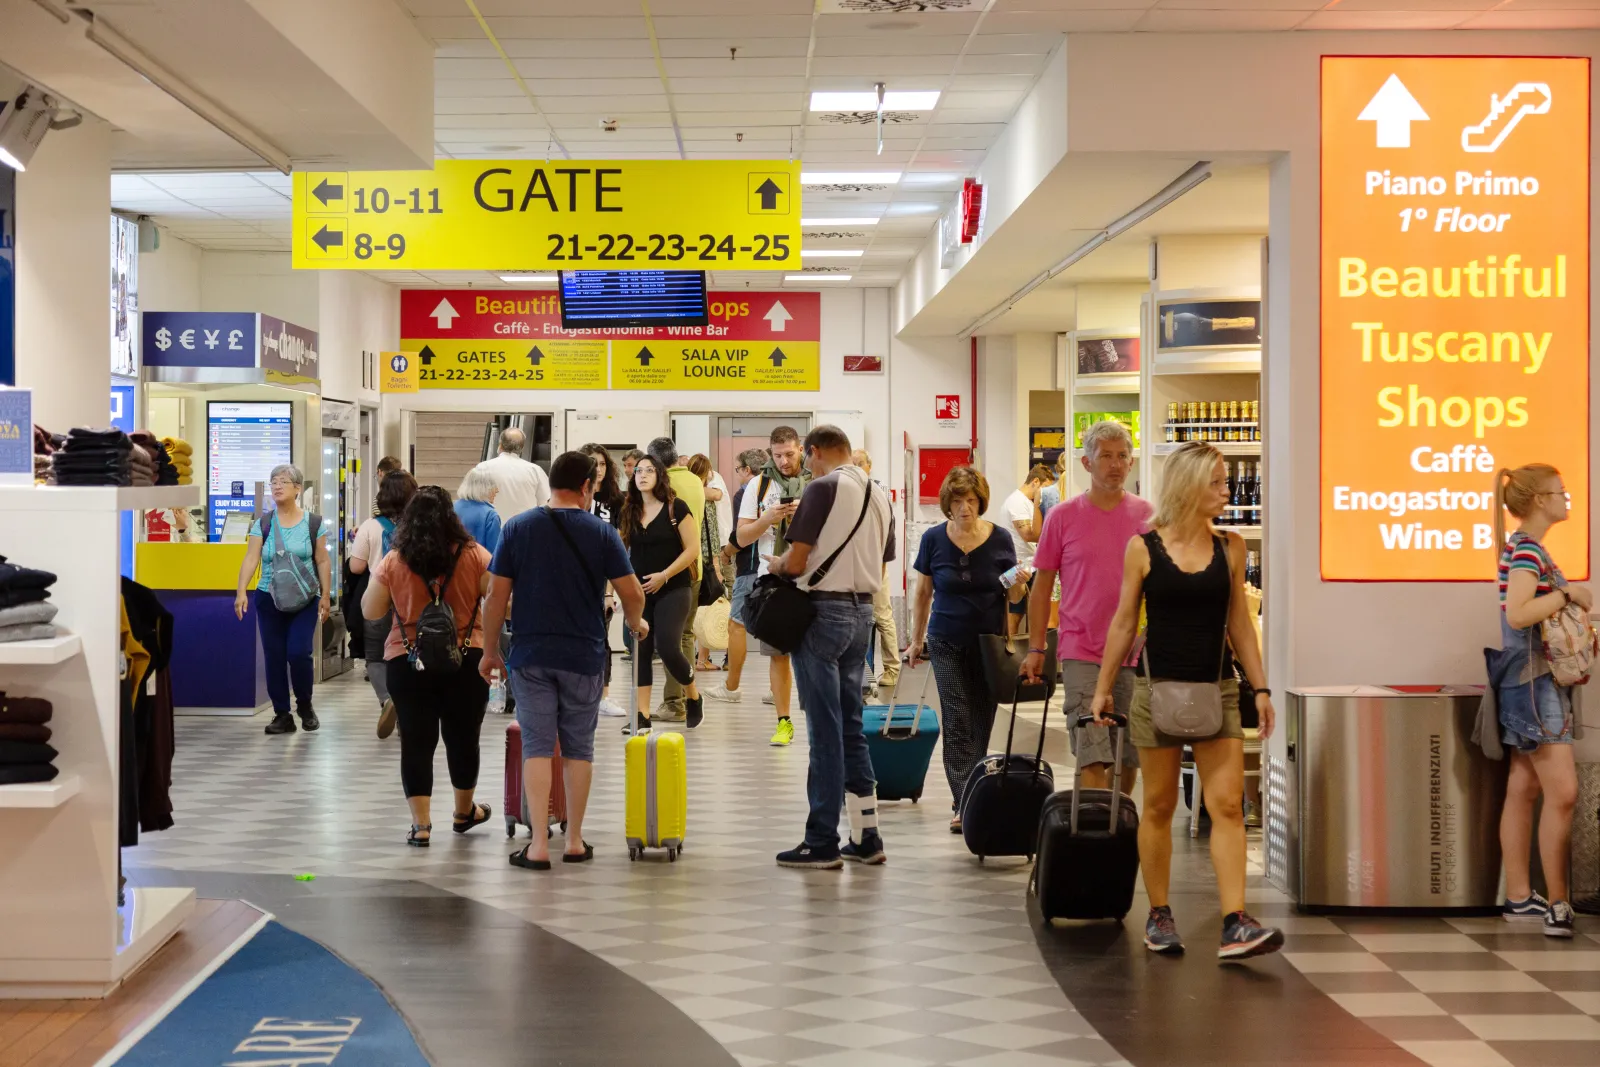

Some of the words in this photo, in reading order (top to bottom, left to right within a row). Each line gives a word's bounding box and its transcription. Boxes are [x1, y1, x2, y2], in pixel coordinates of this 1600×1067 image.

[473, 167, 624, 213] GATE
[1366, 170, 1447, 195] Piano
[1455, 170, 1539, 196] Primo
[354, 187, 443, 214] 10-11
[1434, 206, 1511, 233] Floor
[354, 233, 406, 260] 8-9
[1339, 254, 1566, 298] Beautiful
[155, 326, 172, 352] $
[179, 328, 196, 350] €
[204, 328, 220, 350] ¥
[228, 328, 244, 351] £
[493, 322, 530, 335] Caffè
[667, 324, 702, 336] Wine
[706, 324, 729, 336] Bar
[457, 351, 506, 364] GATES
[681, 348, 721, 361] SALA
[725, 349, 749, 361] VIP
[1351, 322, 1553, 374] Tuscany
[684, 365, 746, 378] LOUNGE
[1377, 384, 1529, 438] Shops
[1411, 444, 1494, 473] Caffè
[215, 499, 230, 507] ENJOY
[231, 499, 240, 507] THE
[1380, 523, 1463, 550] Wine
[1430, 734, 1442, 846] INDIFFERENZIATI
[1430, 851, 1442, 895] RIFIUTI
